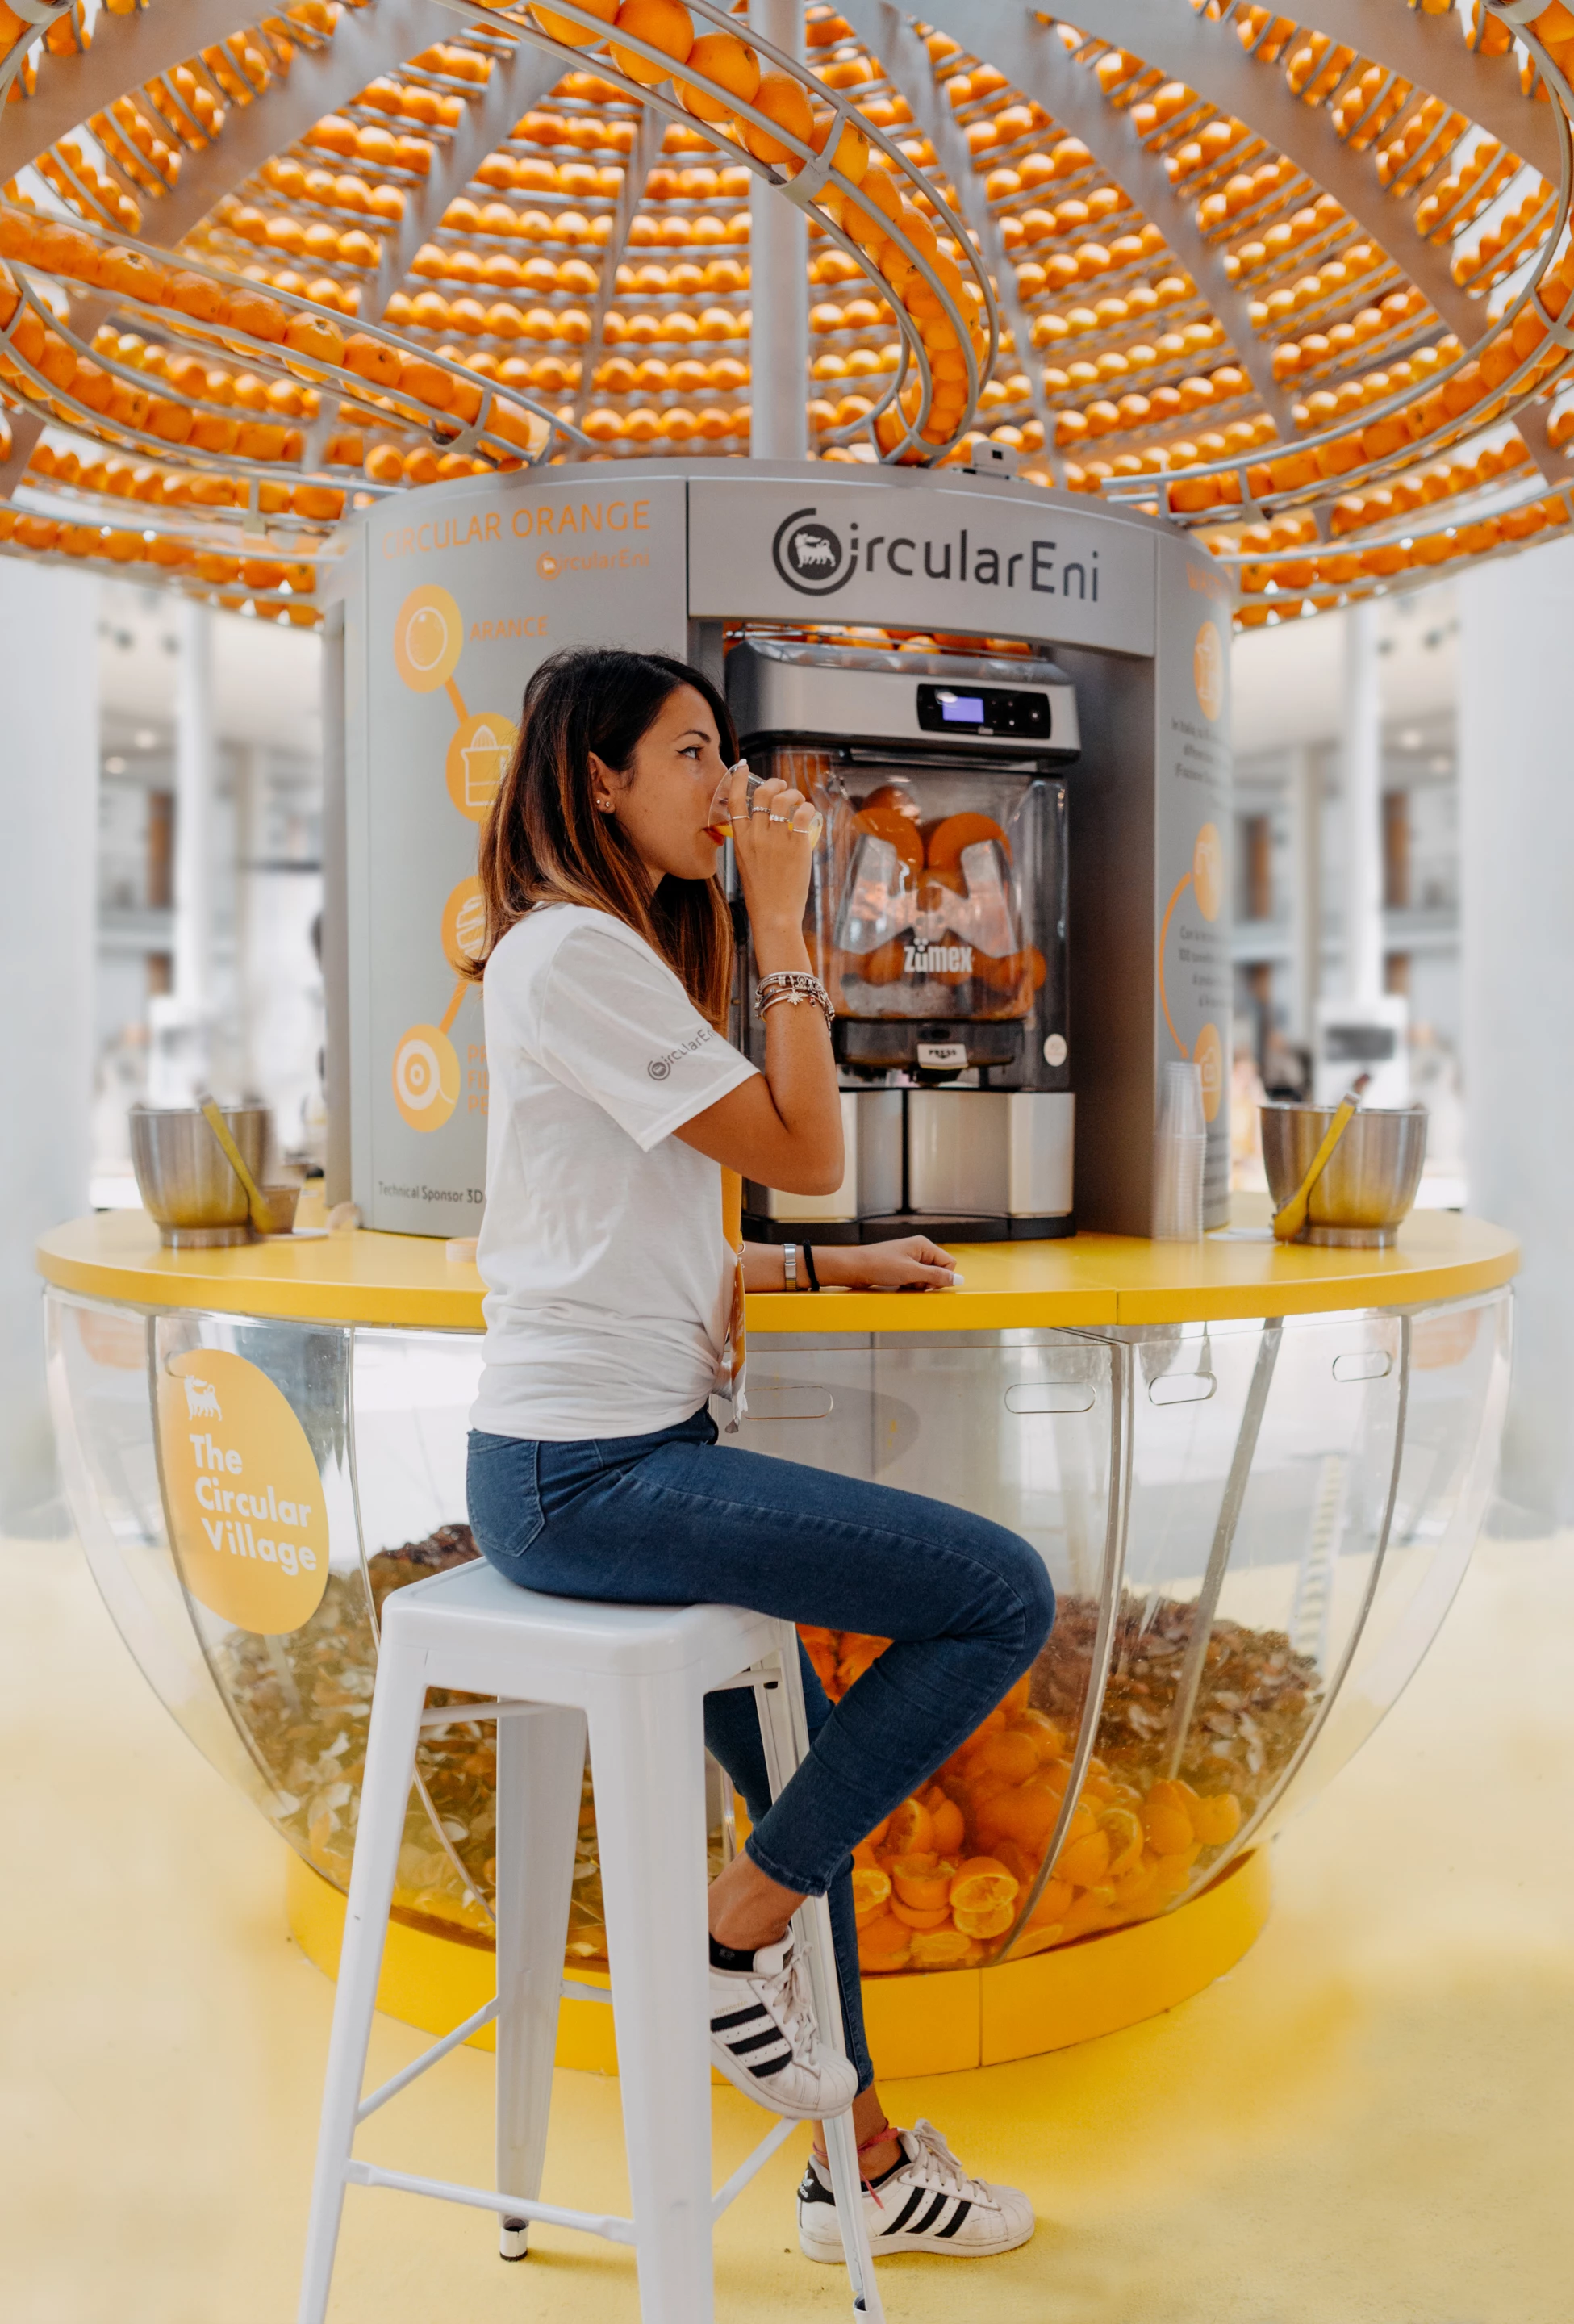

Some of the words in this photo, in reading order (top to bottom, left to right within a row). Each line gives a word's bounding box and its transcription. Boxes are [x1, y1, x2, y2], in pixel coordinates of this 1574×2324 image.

[382, 512, 501, 560] CIRCULAR
[511, 500, 650, 538] ORANGE
[469, 615, 549, 642] ARANCE
[378, 1181, 420, 1200] Technical
[421, 1185, 464, 1203] Sponsor
[466, 1188, 483, 1204] 3D
[190, 1433, 242, 1475] The
[195, 1476, 311, 1528] Circular
[201, 1516, 317, 1576] Village
